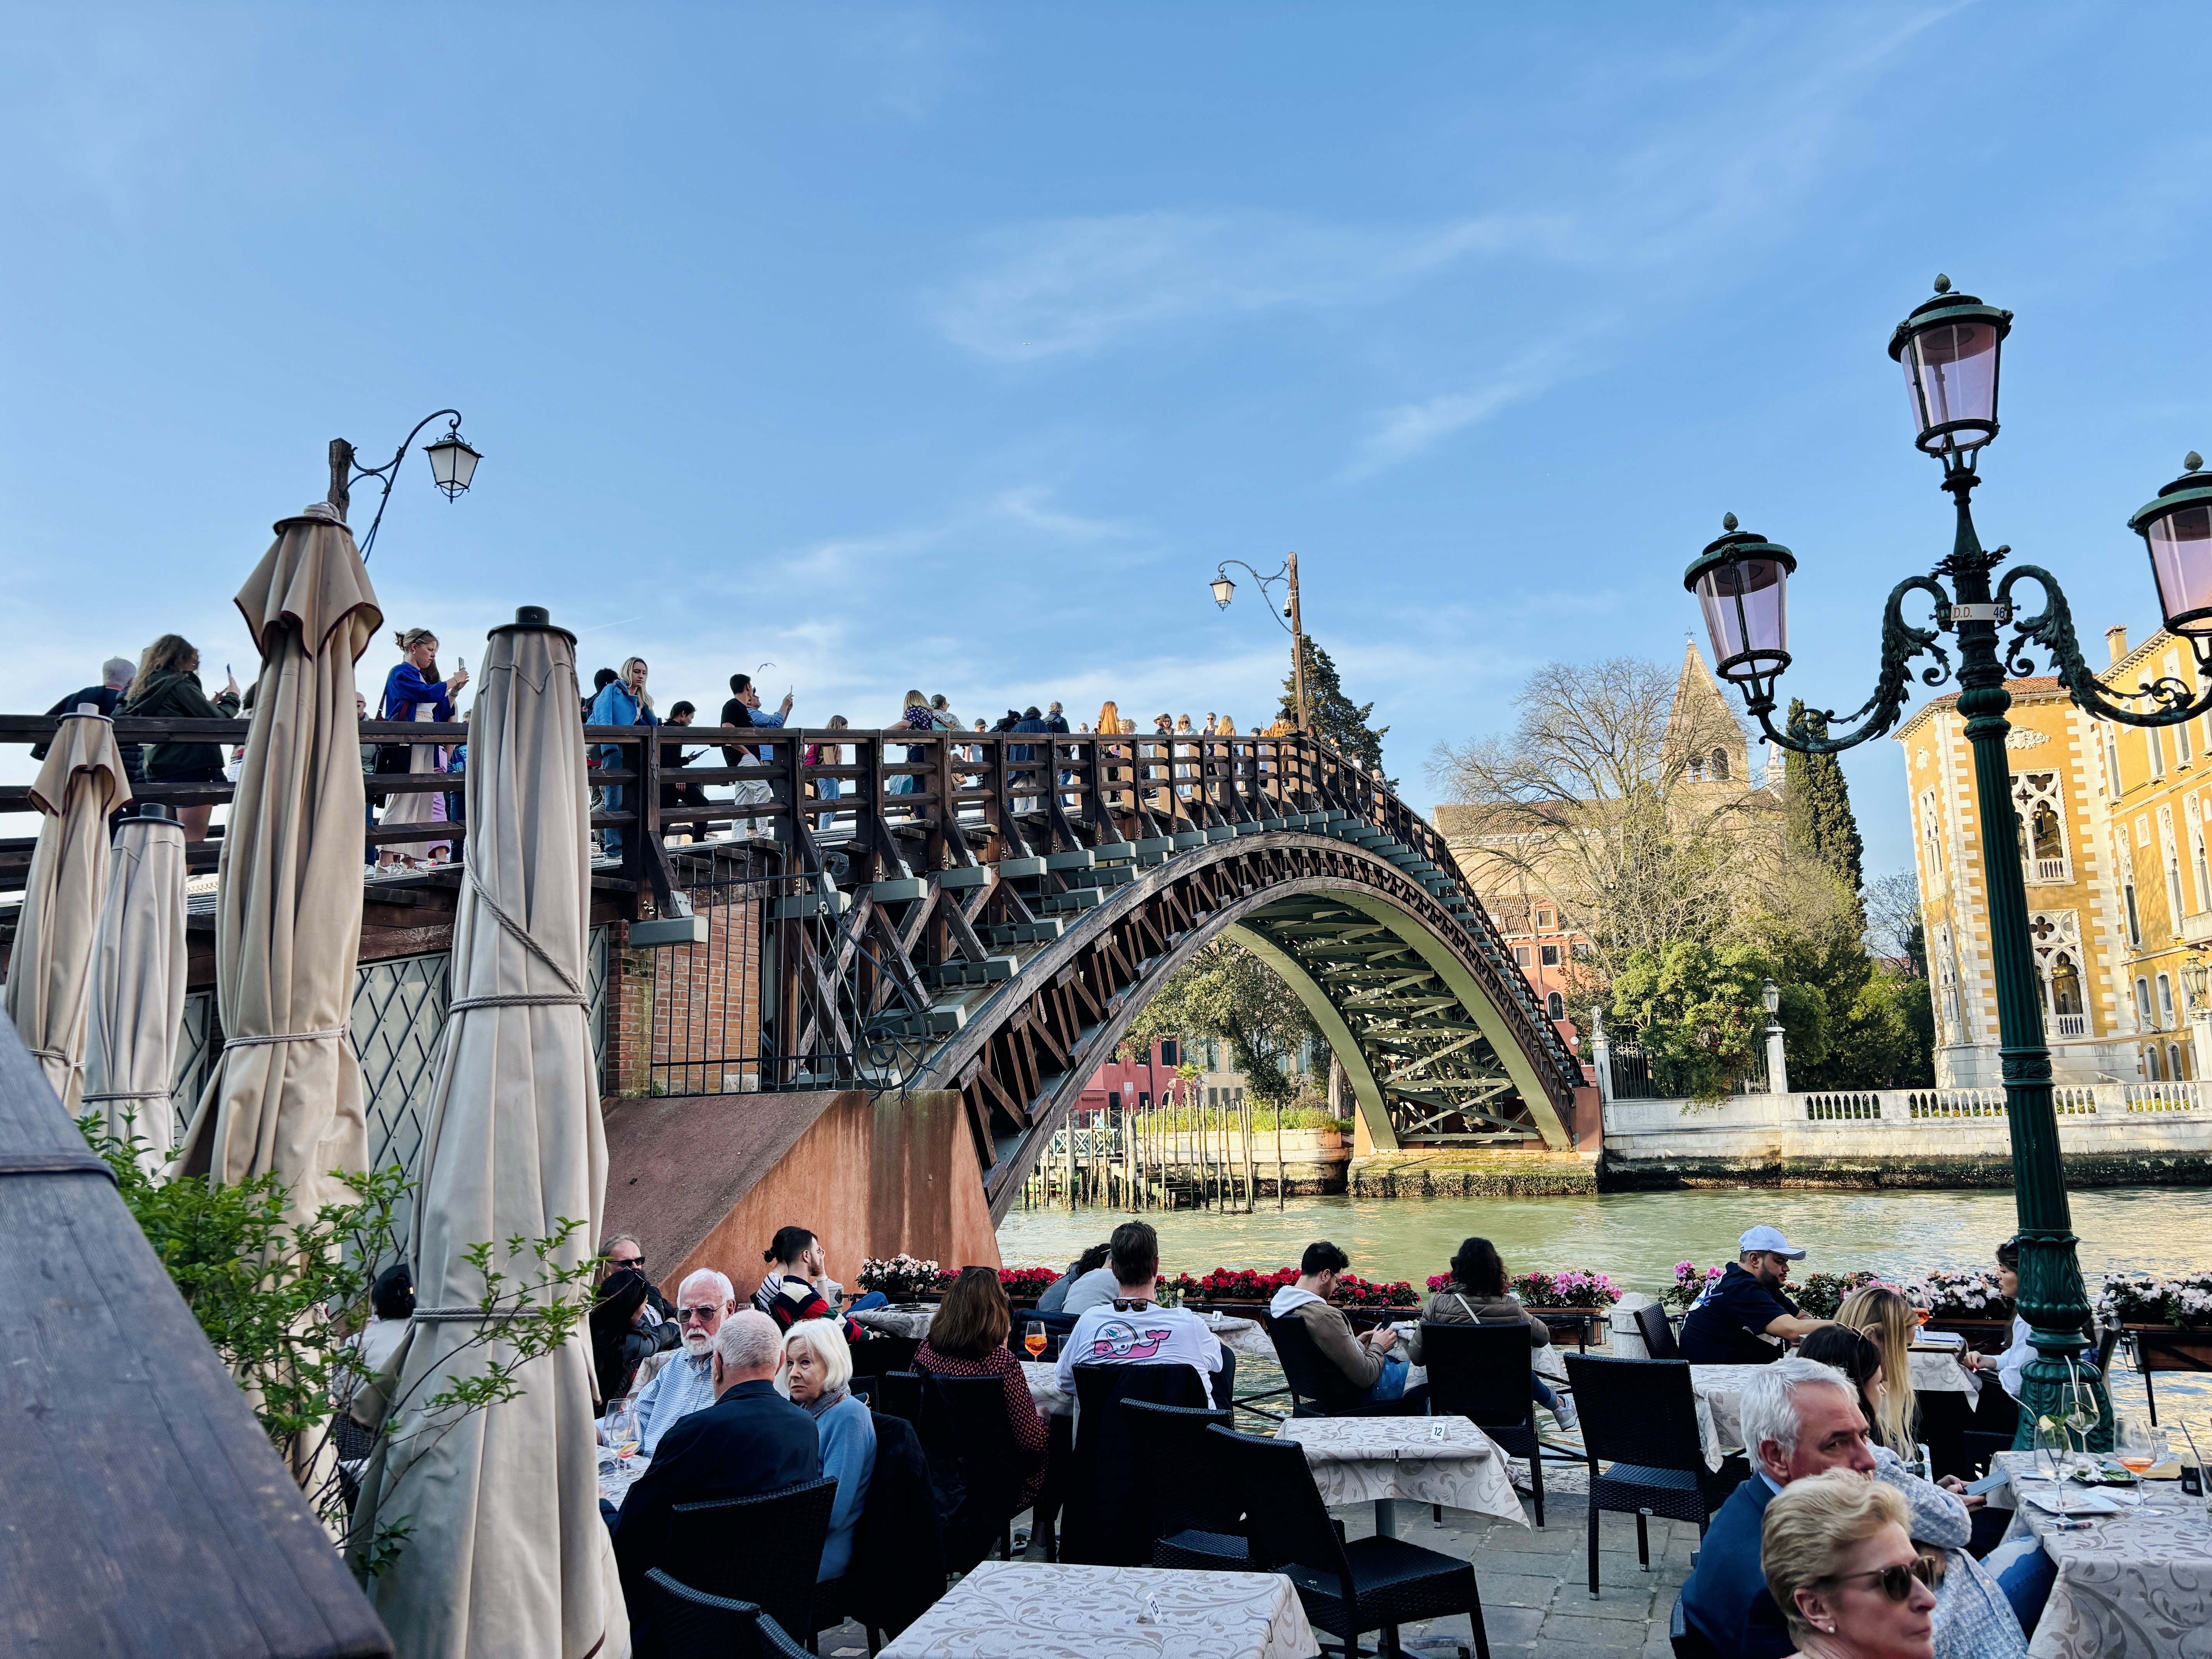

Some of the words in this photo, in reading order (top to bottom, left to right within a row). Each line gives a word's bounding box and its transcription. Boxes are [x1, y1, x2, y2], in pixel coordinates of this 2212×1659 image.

[1993, 606, 2005, 618] 46
[1434, 1427, 1442, 1436] 12
[1151, 1600, 1159, 1616] 13
